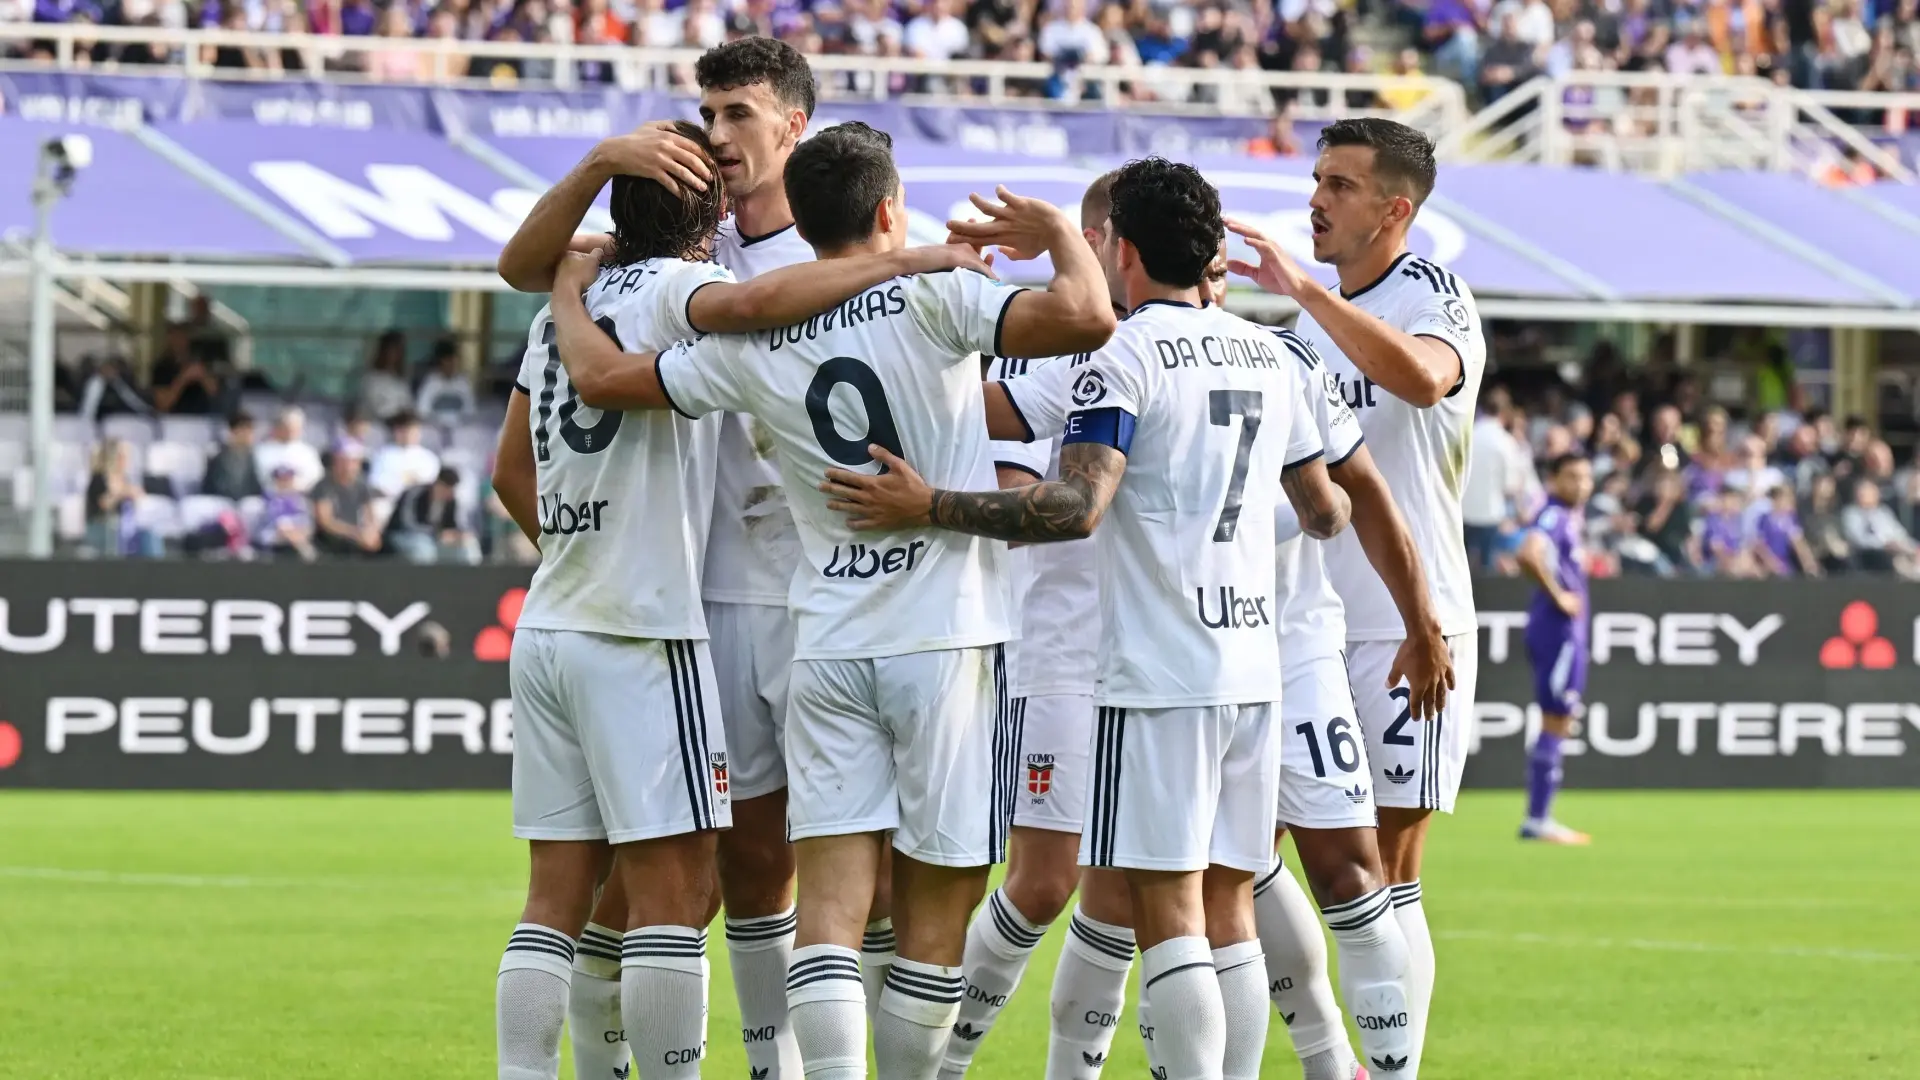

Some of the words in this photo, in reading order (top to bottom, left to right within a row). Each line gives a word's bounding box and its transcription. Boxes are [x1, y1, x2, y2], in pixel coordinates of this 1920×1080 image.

[1155, 337, 1199, 369] DA
[1201, 336, 1280, 369] CUNHA
[805, 356, 906, 476] 9
[1208, 389, 1263, 543] 7
[541, 492, 609, 535] Uber
[823, 540, 924, 579] Uber
[1197, 586, 1270, 629] Uber
[1478, 611, 1784, 666] TREY
[1383, 687, 1414, 746] 2
[1467, 702, 1920, 756] PEUTERE
[1027, 753, 1055, 763] COMO
[1296, 716, 1360, 778] 16
[743, 1025, 775, 1043] OMO
[1356, 1012, 1408, 1030] COMO
